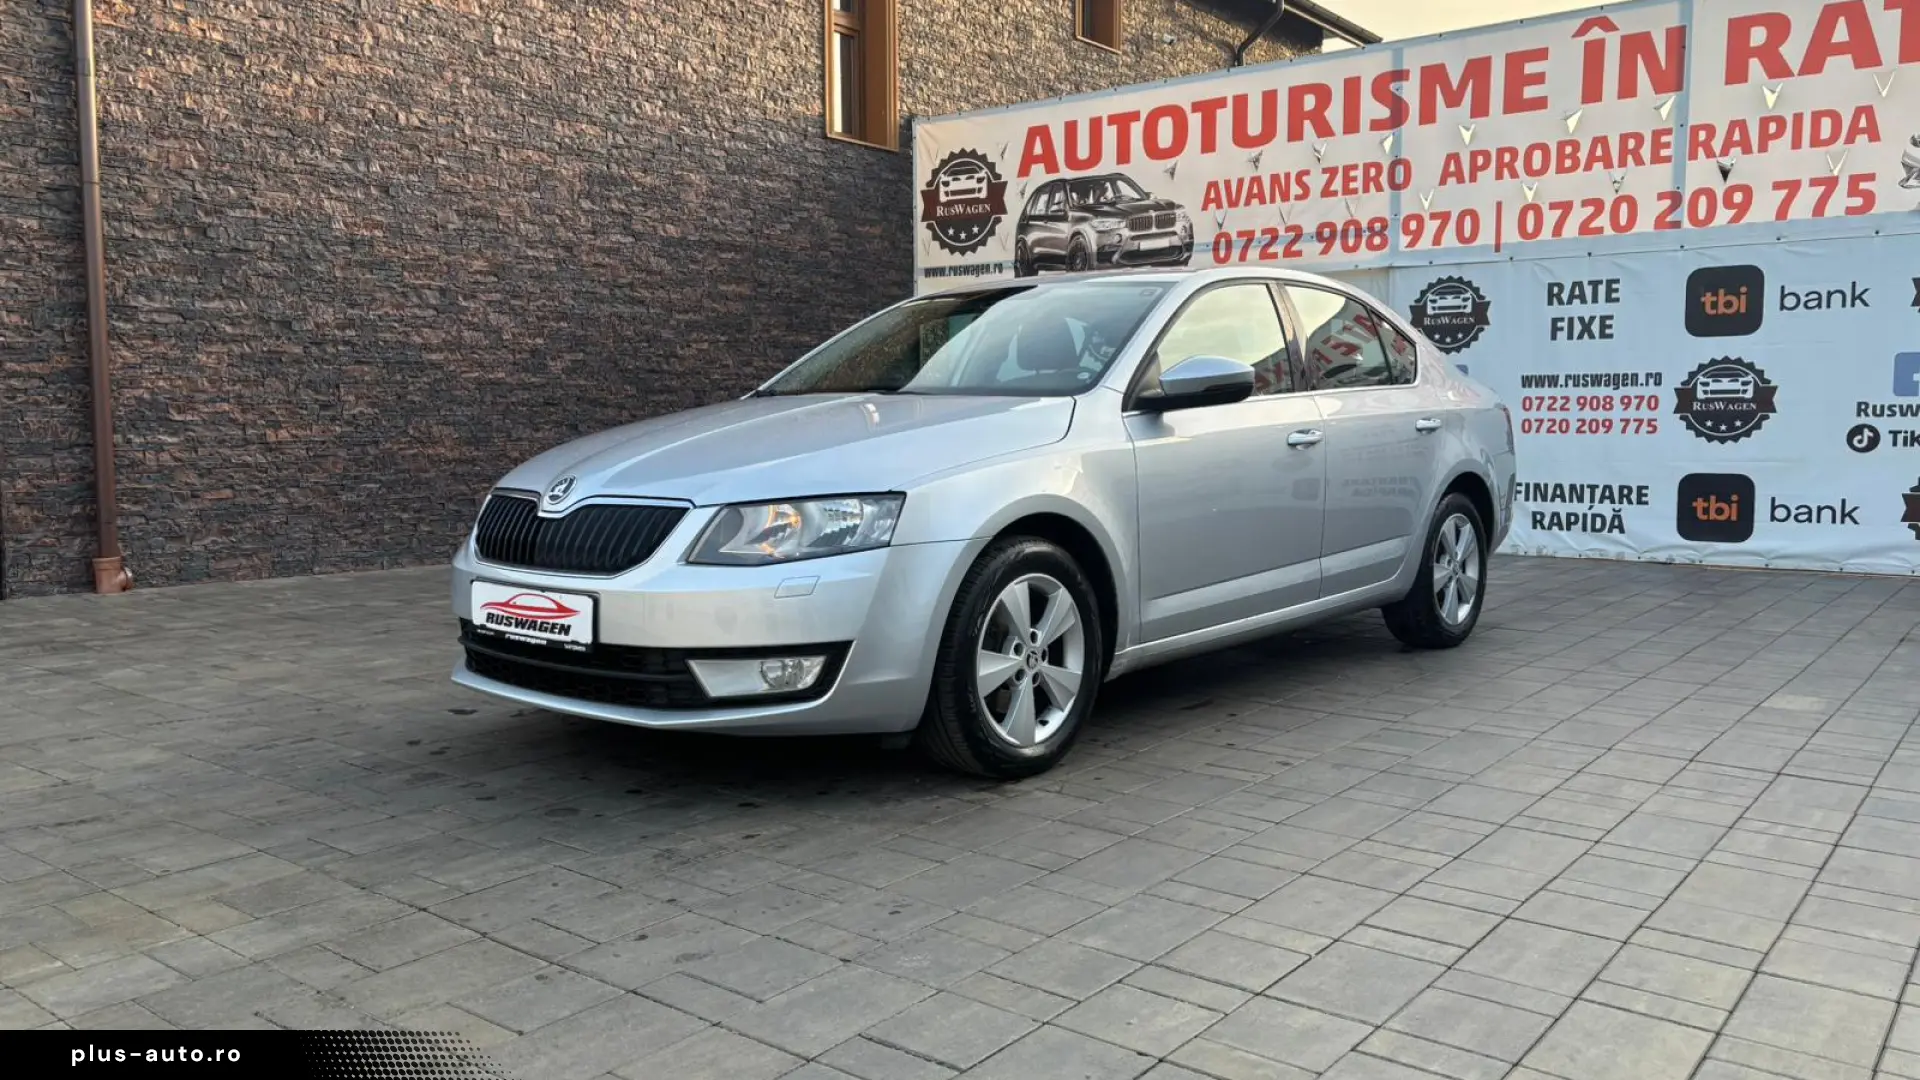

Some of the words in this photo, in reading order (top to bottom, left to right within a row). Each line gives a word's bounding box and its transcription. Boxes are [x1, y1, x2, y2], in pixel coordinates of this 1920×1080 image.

[1017, 46, 1549, 178] AUTOTURISME
[1571, 16, 1687, 104] ÎN
[1438, 127, 1673, 187] APROBARE
[1687, 104, 1881, 161] RAPIDA
[1201, 168, 1311, 211] AVANS
[1320, 157, 1412, 199] ZERO
[1212, 223, 1304, 265] 0722
[1315, 216, 1389, 256] 908
[1401, 208, 1481, 248] 970
[1517, 194, 1638, 241] 0720
[1654, 183, 1754, 231] 209
[1771, 172, 1877, 222] 775
[924, 262, 1004, 278] www.ruswagen.ro
[1547, 278, 1621, 306] RATE
[1701, 286, 1748, 315] tbi
[1779, 281, 1871, 312] bank
[1550, 314, 1614, 341] FIXE
[1521, 372, 1663, 391] www.ruswagen.ro
[1522, 395, 1571, 412] 0722
[1576, 395, 1615, 412] 908
[1620, 395, 1660, 412] 970
[1521, 418, 1570, 434] 0720
[1575, 418, 1614, 434] 209
[1620, 418, 1658, 434] 775
[1531, 508, 1626, 535] RAPIDĂ
[1692, 494, 1740, 522] tbi
[1770, 496, 1861, 526] bank
[485, 611, 572, 637] RUSWAGEN
